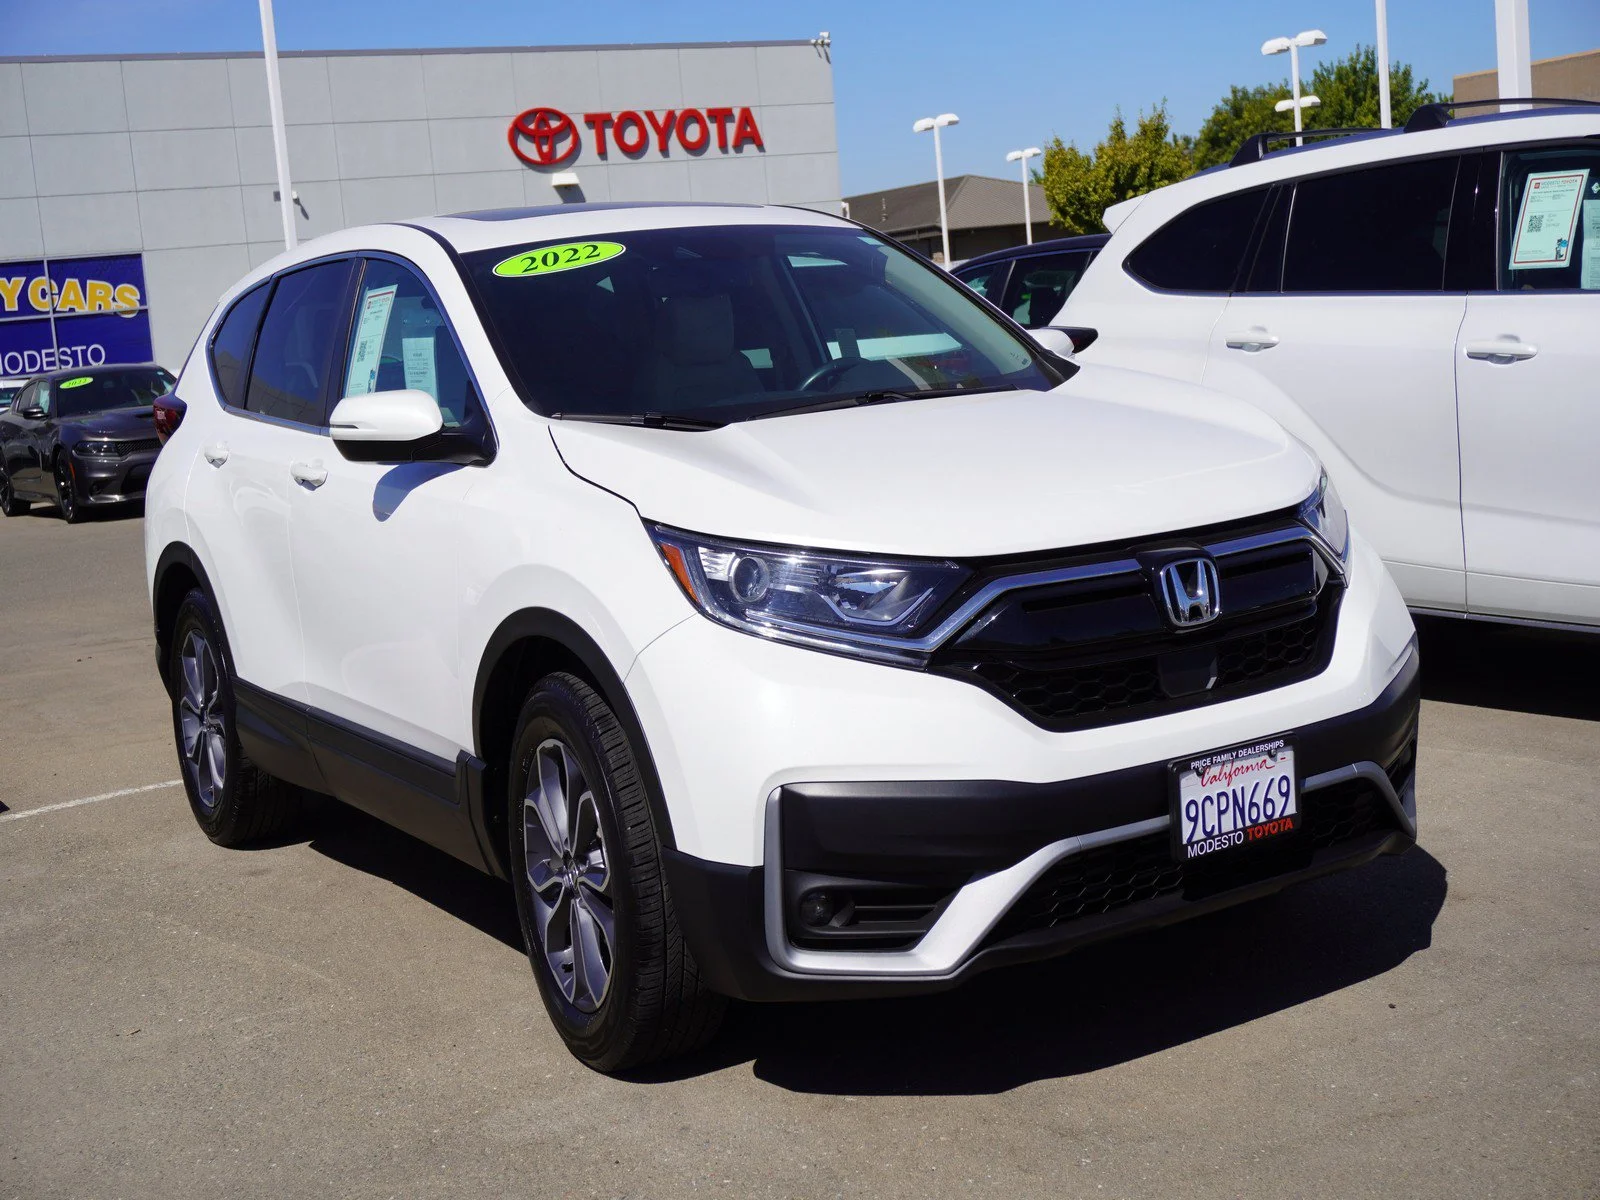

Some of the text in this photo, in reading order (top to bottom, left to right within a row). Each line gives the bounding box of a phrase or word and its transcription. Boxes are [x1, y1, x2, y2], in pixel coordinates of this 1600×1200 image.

[584, 107, 763, 155] TOYOTA
[520, 244, 601, 273] 2022
[28, 276, 140, 318] CARS
[1190, 739, 1284, 770] PRICE FAMILY DEALERSHIPS
[1201, 756, 1275, 787] California
[1185, 775, 1291, 843] 9CPN669
[1187, 817, 1294, 858] MODESTO TOYOTA
